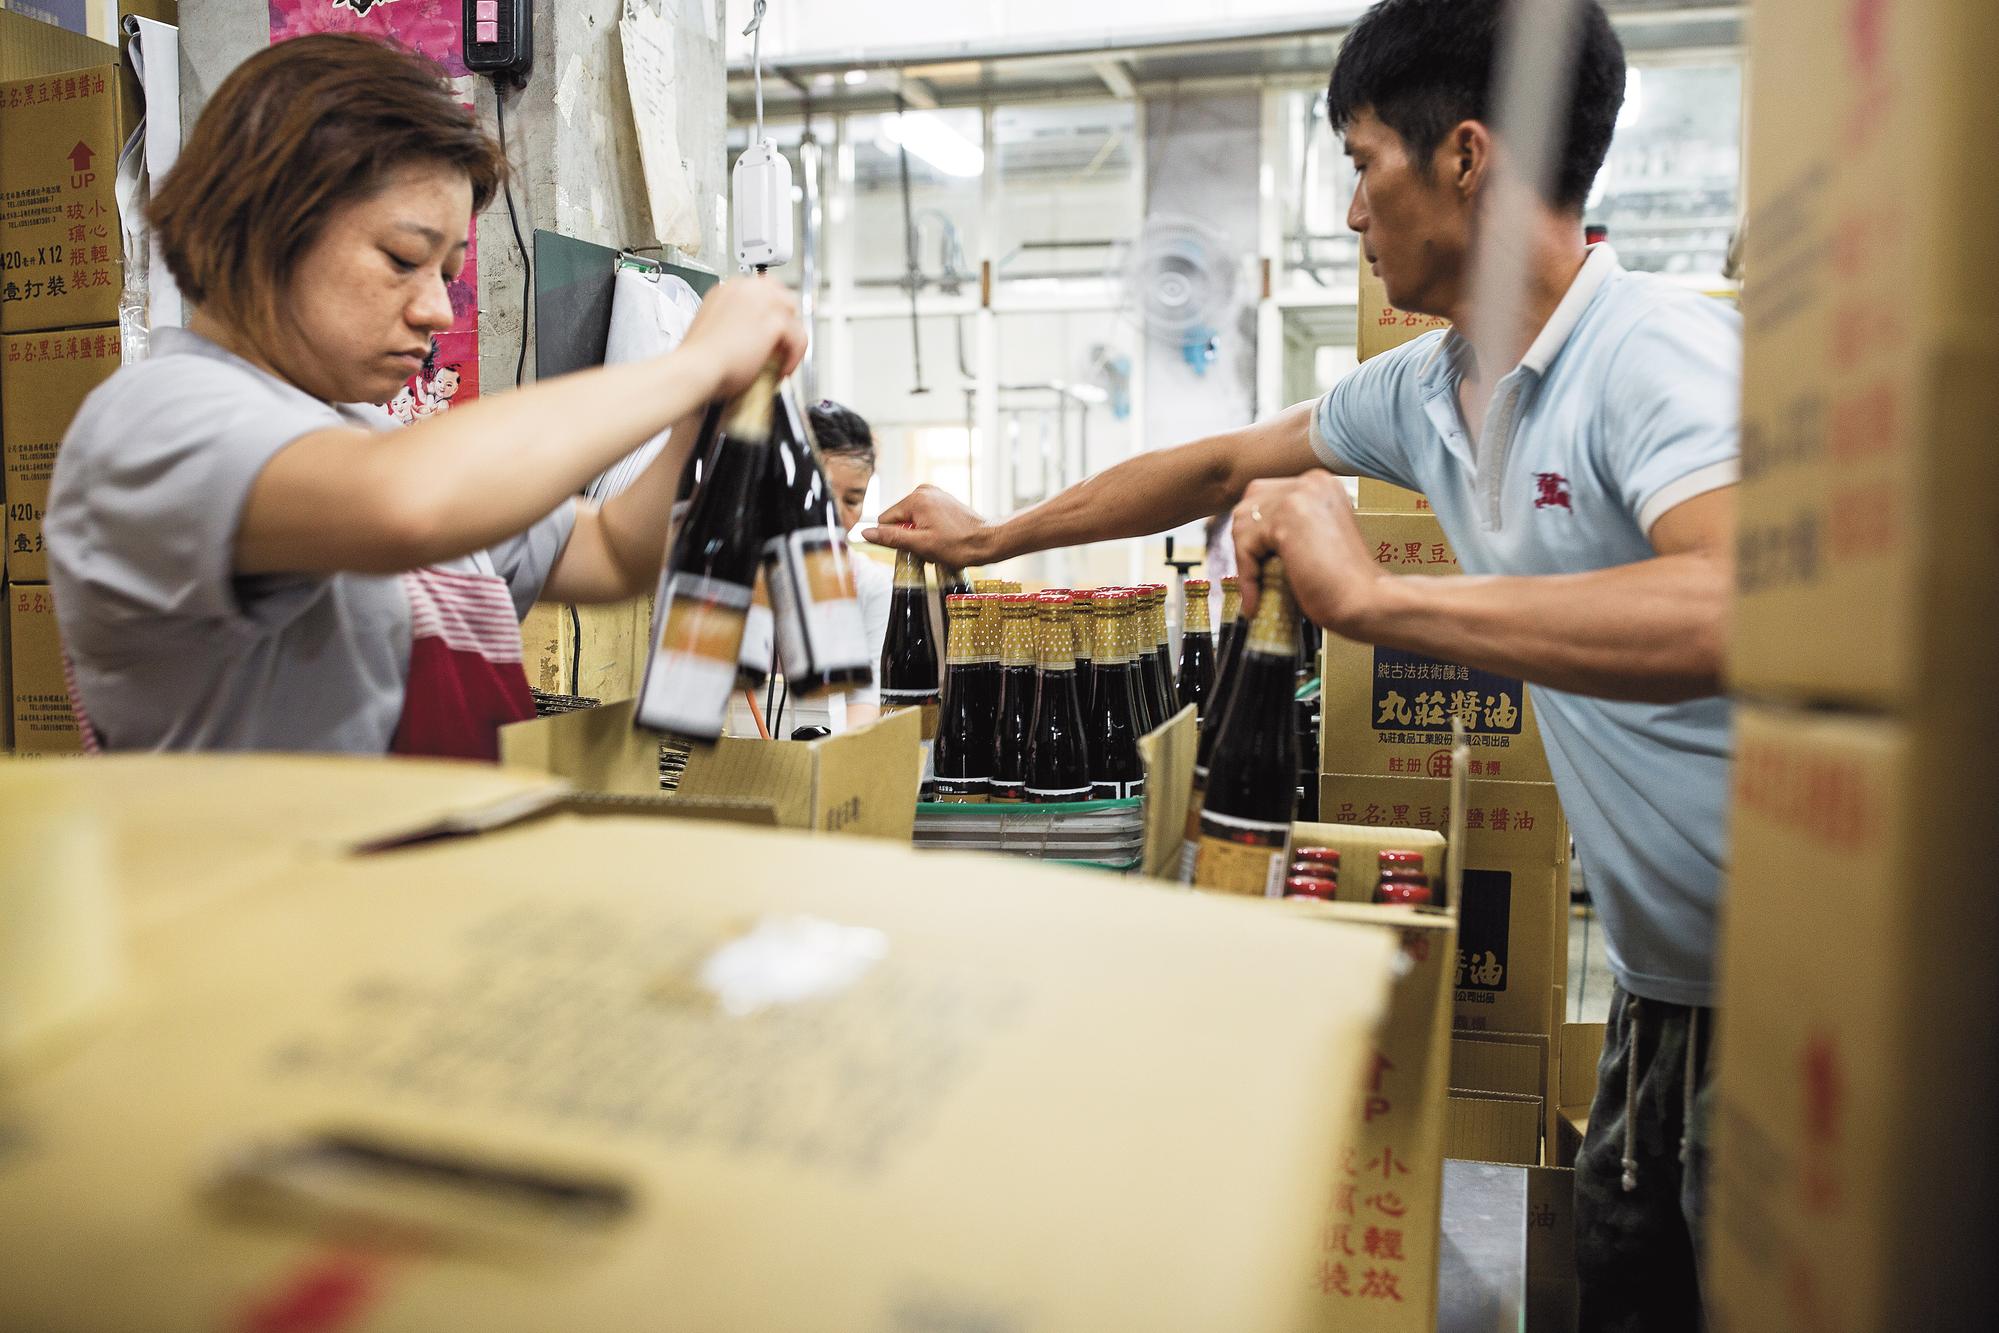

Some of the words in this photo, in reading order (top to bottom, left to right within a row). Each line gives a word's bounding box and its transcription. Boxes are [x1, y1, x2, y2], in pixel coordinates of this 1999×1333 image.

[70, 173, 96, 189] UP
[49, 245, 63, 264] 12
[66, 201, 90, 290] 玻璃瓶裝
[88, 199, 112, 288] 小心輕放
[3, 275, 68, 303] 壹打裝
[8, 334, 120, 362] 品名:黑豆薄鹽醬油
[1375, 541, 1457, 565] 名:黑豆
[1378, 662, 1470, 681] 純古法技術釀造
[1377, 689, 1518, 730] 丸莊醬油
[1378, 732, 1510, 748] 丸莊食品工業股份限公司出品
[1360, 1147, 1410, 1302] 小心輕放
